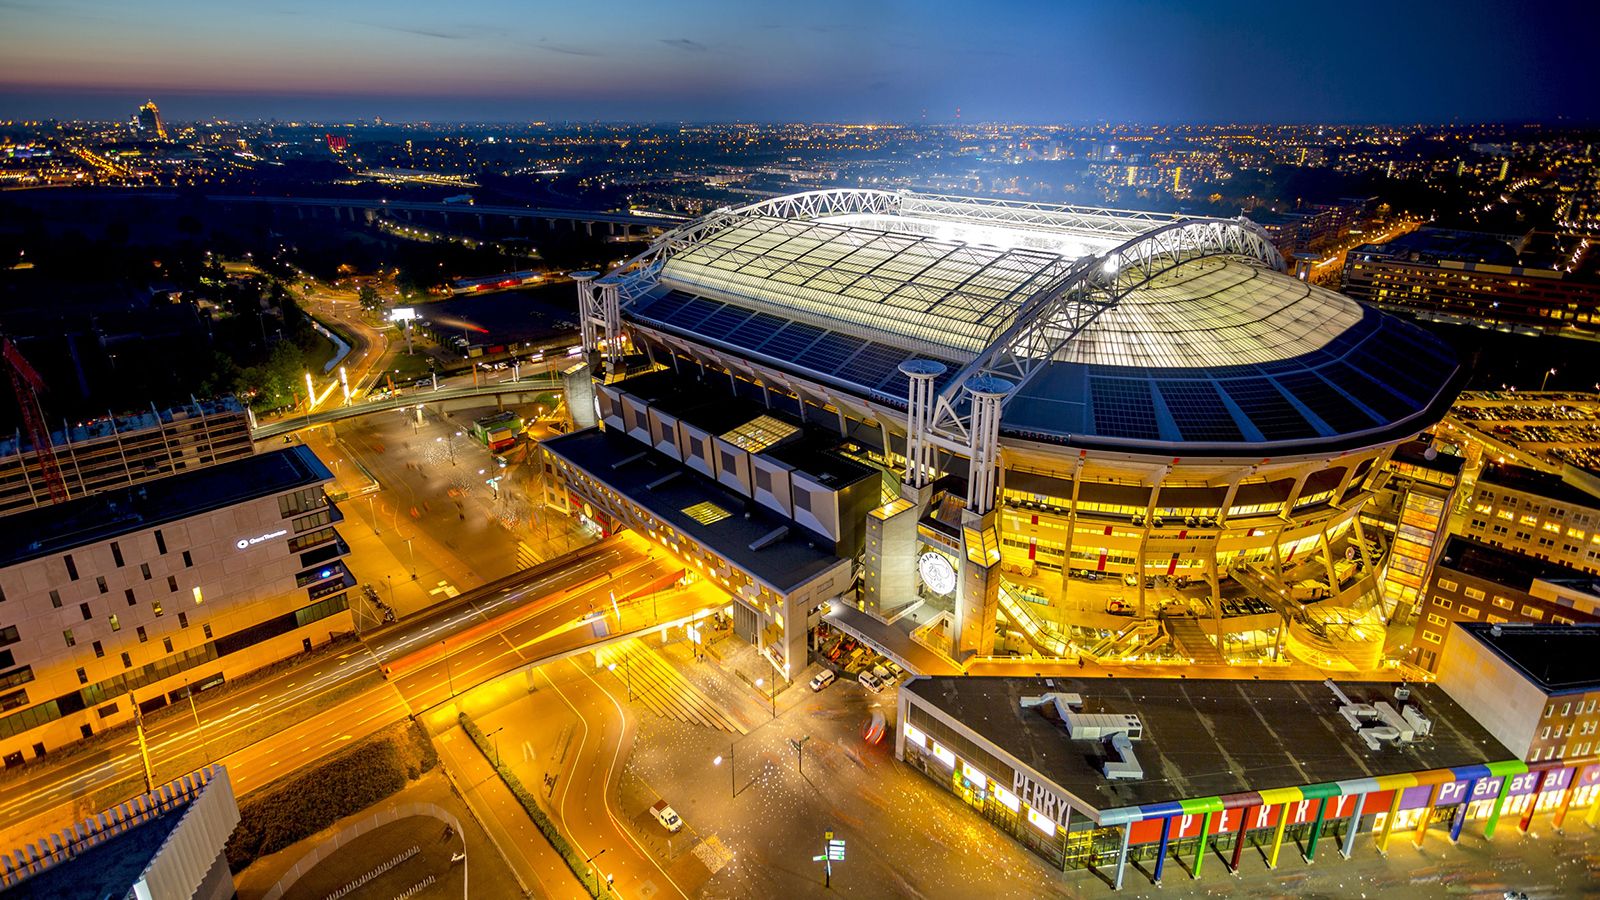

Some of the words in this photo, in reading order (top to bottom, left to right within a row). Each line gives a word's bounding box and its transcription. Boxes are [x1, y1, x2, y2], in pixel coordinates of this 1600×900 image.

[922, 553, 939, 564] AJAX
[1012, 769, 1068, 825] PERRY
[1178, 794, 1349, 838] PERRY
